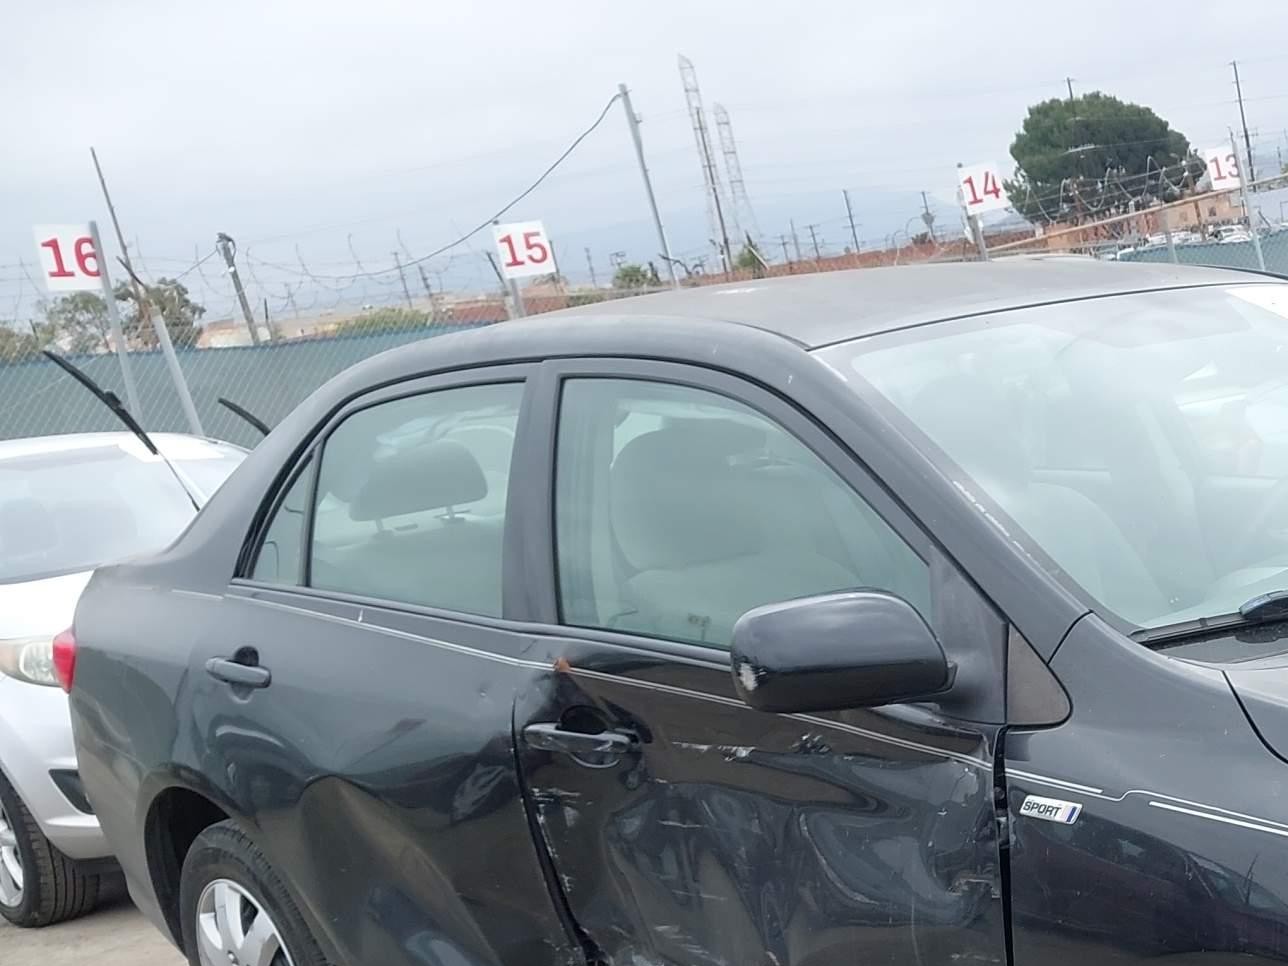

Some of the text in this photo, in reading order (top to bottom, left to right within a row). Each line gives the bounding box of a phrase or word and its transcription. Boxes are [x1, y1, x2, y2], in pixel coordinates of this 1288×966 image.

[1209, 153, 1240, 181] 13
[963, 171, 1001, 206] 14
[41, 236, 102, 278] 16
[499, 231, 548, 268] 15
[1022, 800, 1062, 817] SPORT
